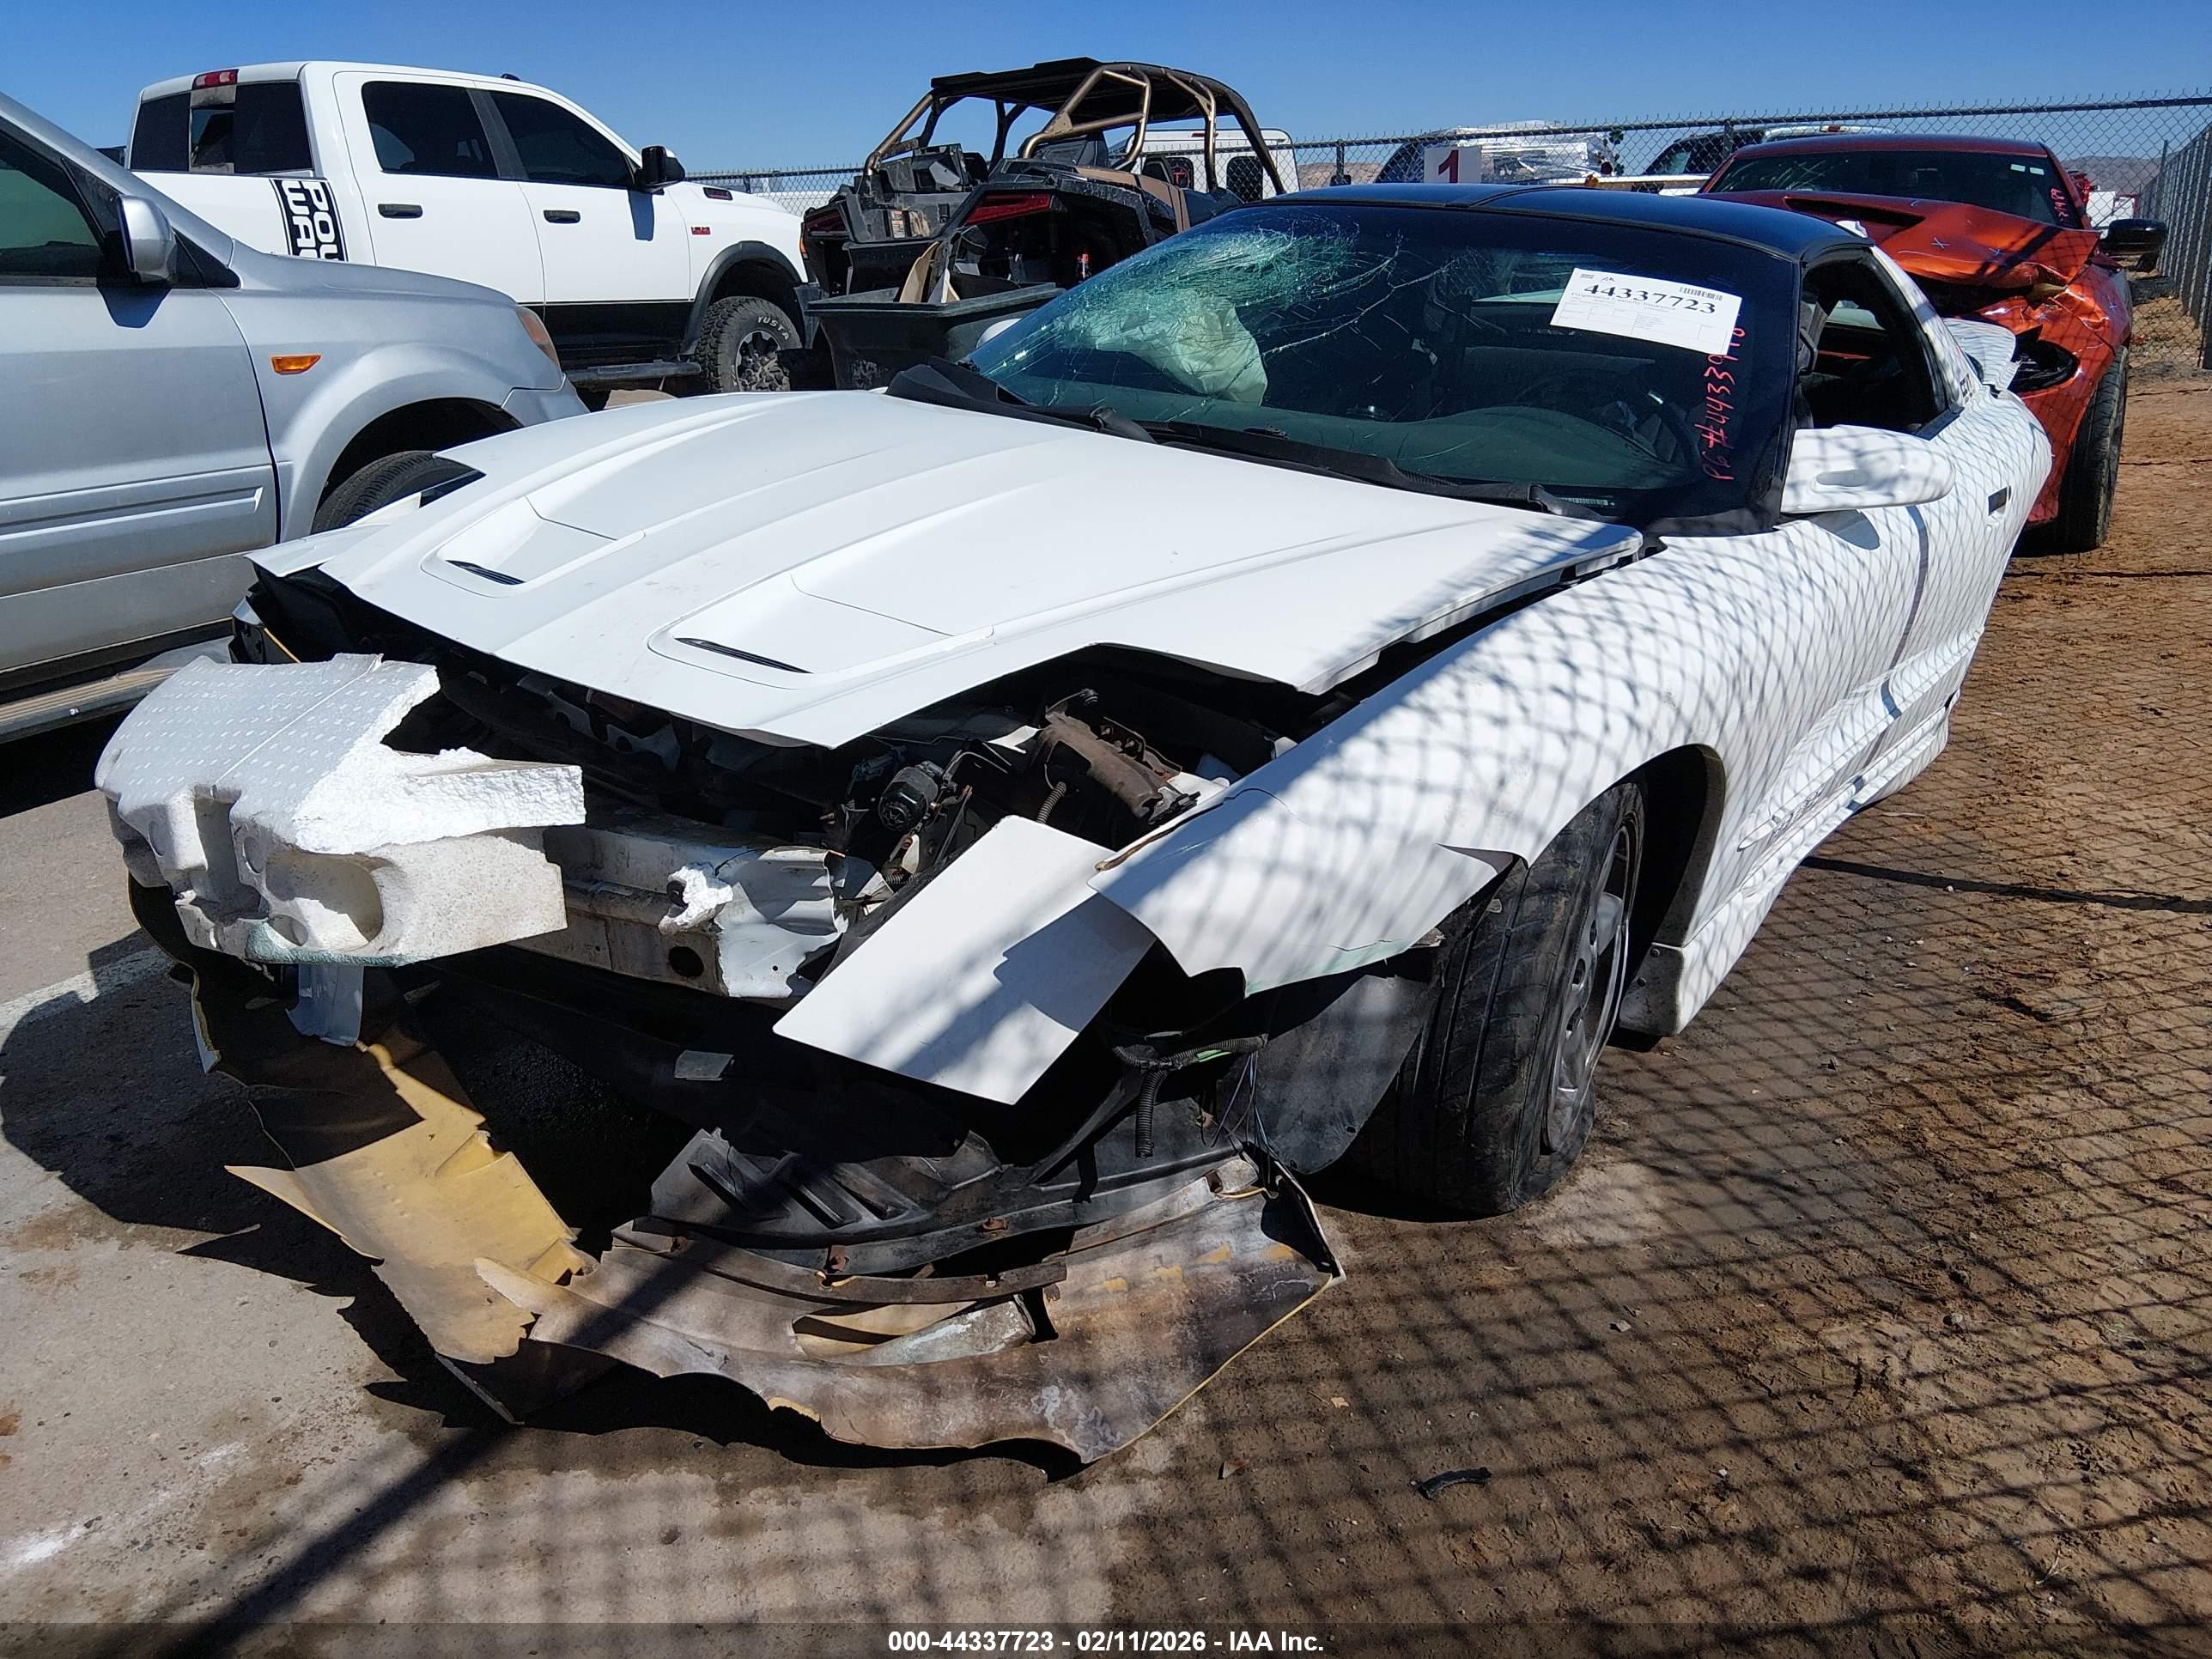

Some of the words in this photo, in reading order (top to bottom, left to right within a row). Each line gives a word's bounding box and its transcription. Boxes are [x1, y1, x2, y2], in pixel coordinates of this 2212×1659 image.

[1437, 149, 1459, 183] 1
[1583, 283, 1716, 314] 44337723
[757, 315, 791, 341] YUSTA
